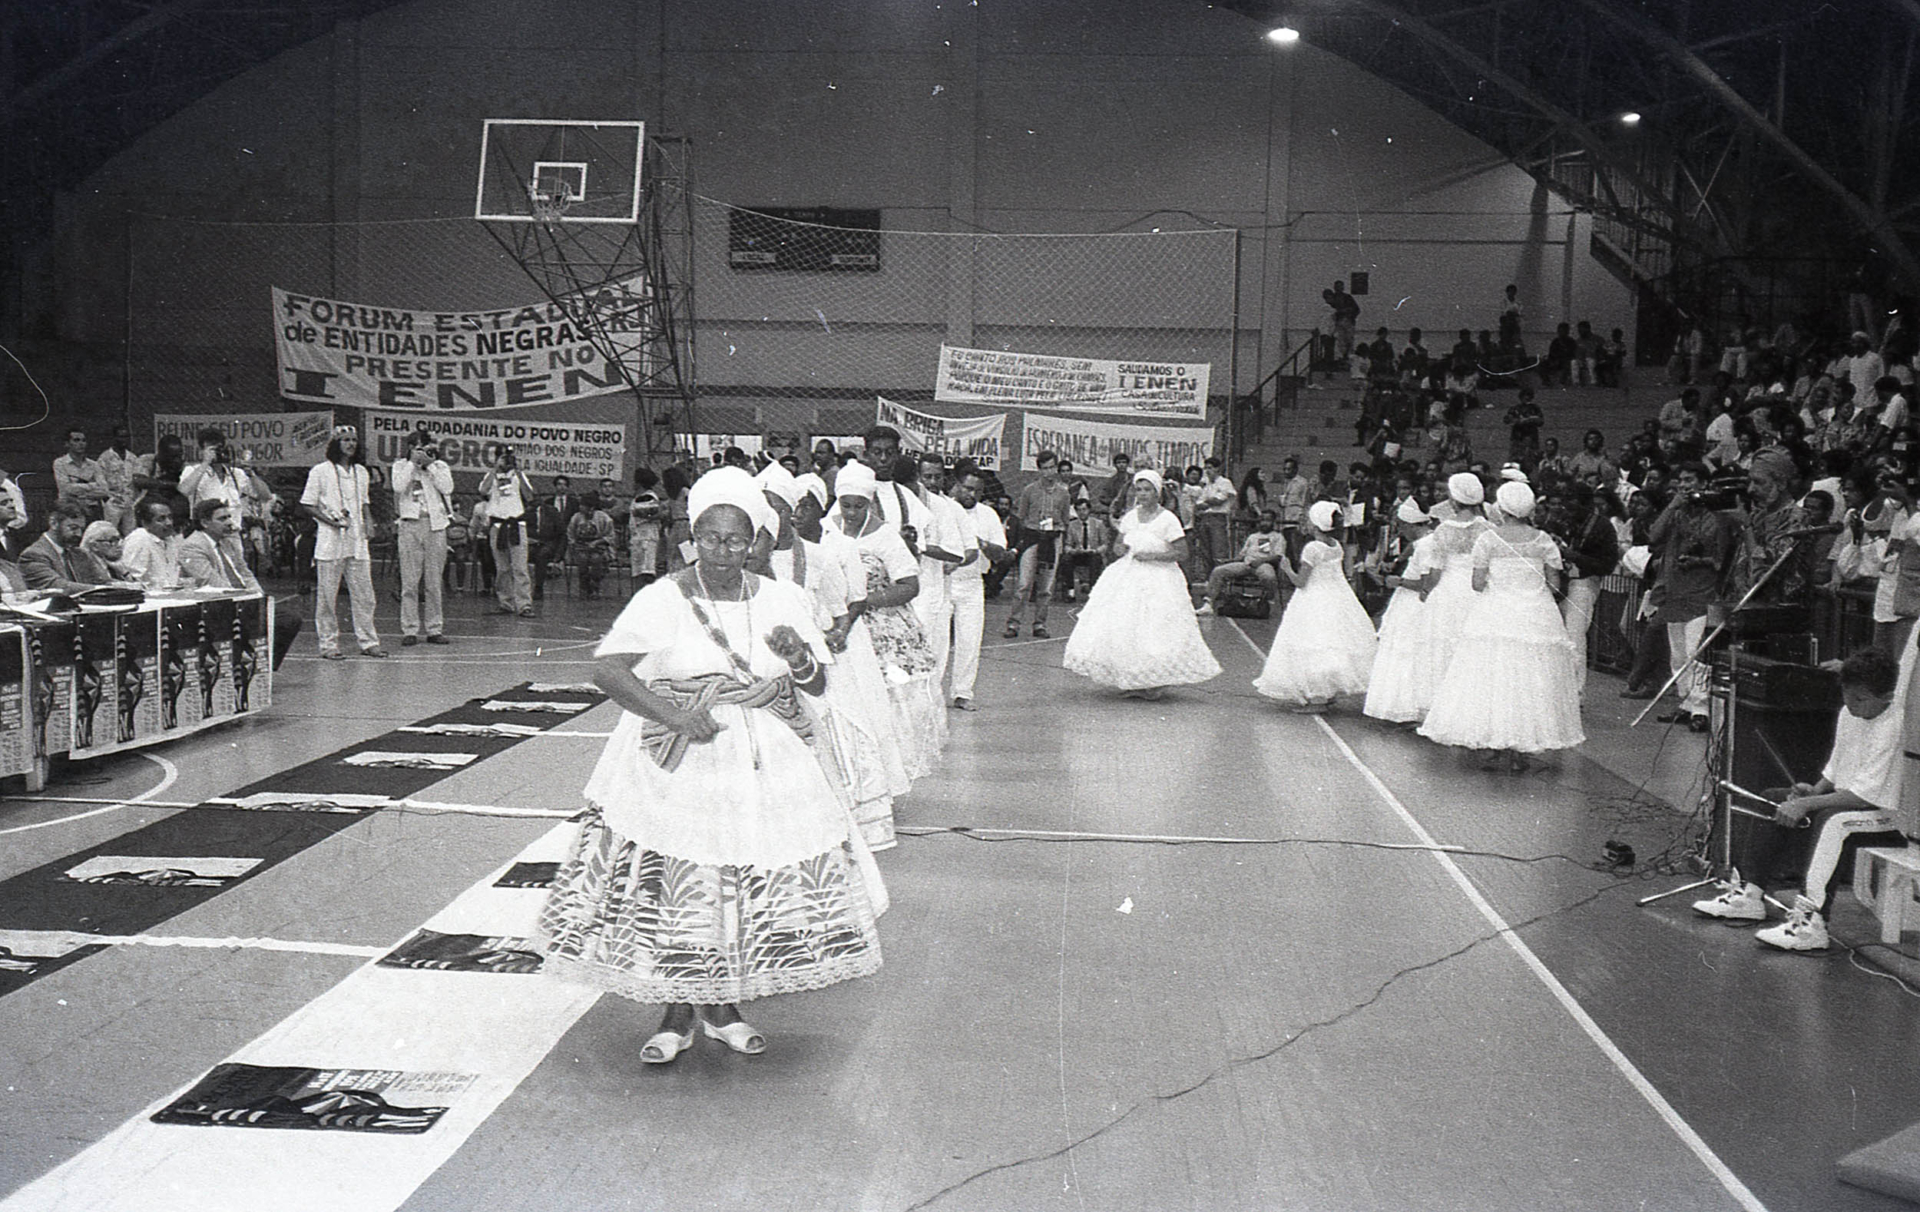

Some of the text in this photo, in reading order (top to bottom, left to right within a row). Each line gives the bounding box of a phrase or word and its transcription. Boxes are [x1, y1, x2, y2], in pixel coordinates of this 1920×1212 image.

[283, 293, 413, 331] FORUM
[285, 321, 317, 343] de
[324, 327, 468, 357] ENTIDADES
[345, 345, 595, 381] PRESENTE NO
[1117, 363, 1185, 376] SAUDAMOS O
[284, 361, 624, 409] I ENEN
[1134, 376, 1197, 391] ENEN
[241, 420, 284, 440] POVO
[373, 417, 622, 445] PELA CIDADANIA DO POVO NEGRO
[879, 401, 944, 436] NA BRIGA
[378, 435, 502, 468] UGRO
[545, 444, 566, 457] DOS
[570, 446, 613, 460] NEGROS
[925, 435, 961, 456] PELA
[969, 436, 998, 457] VIDA
